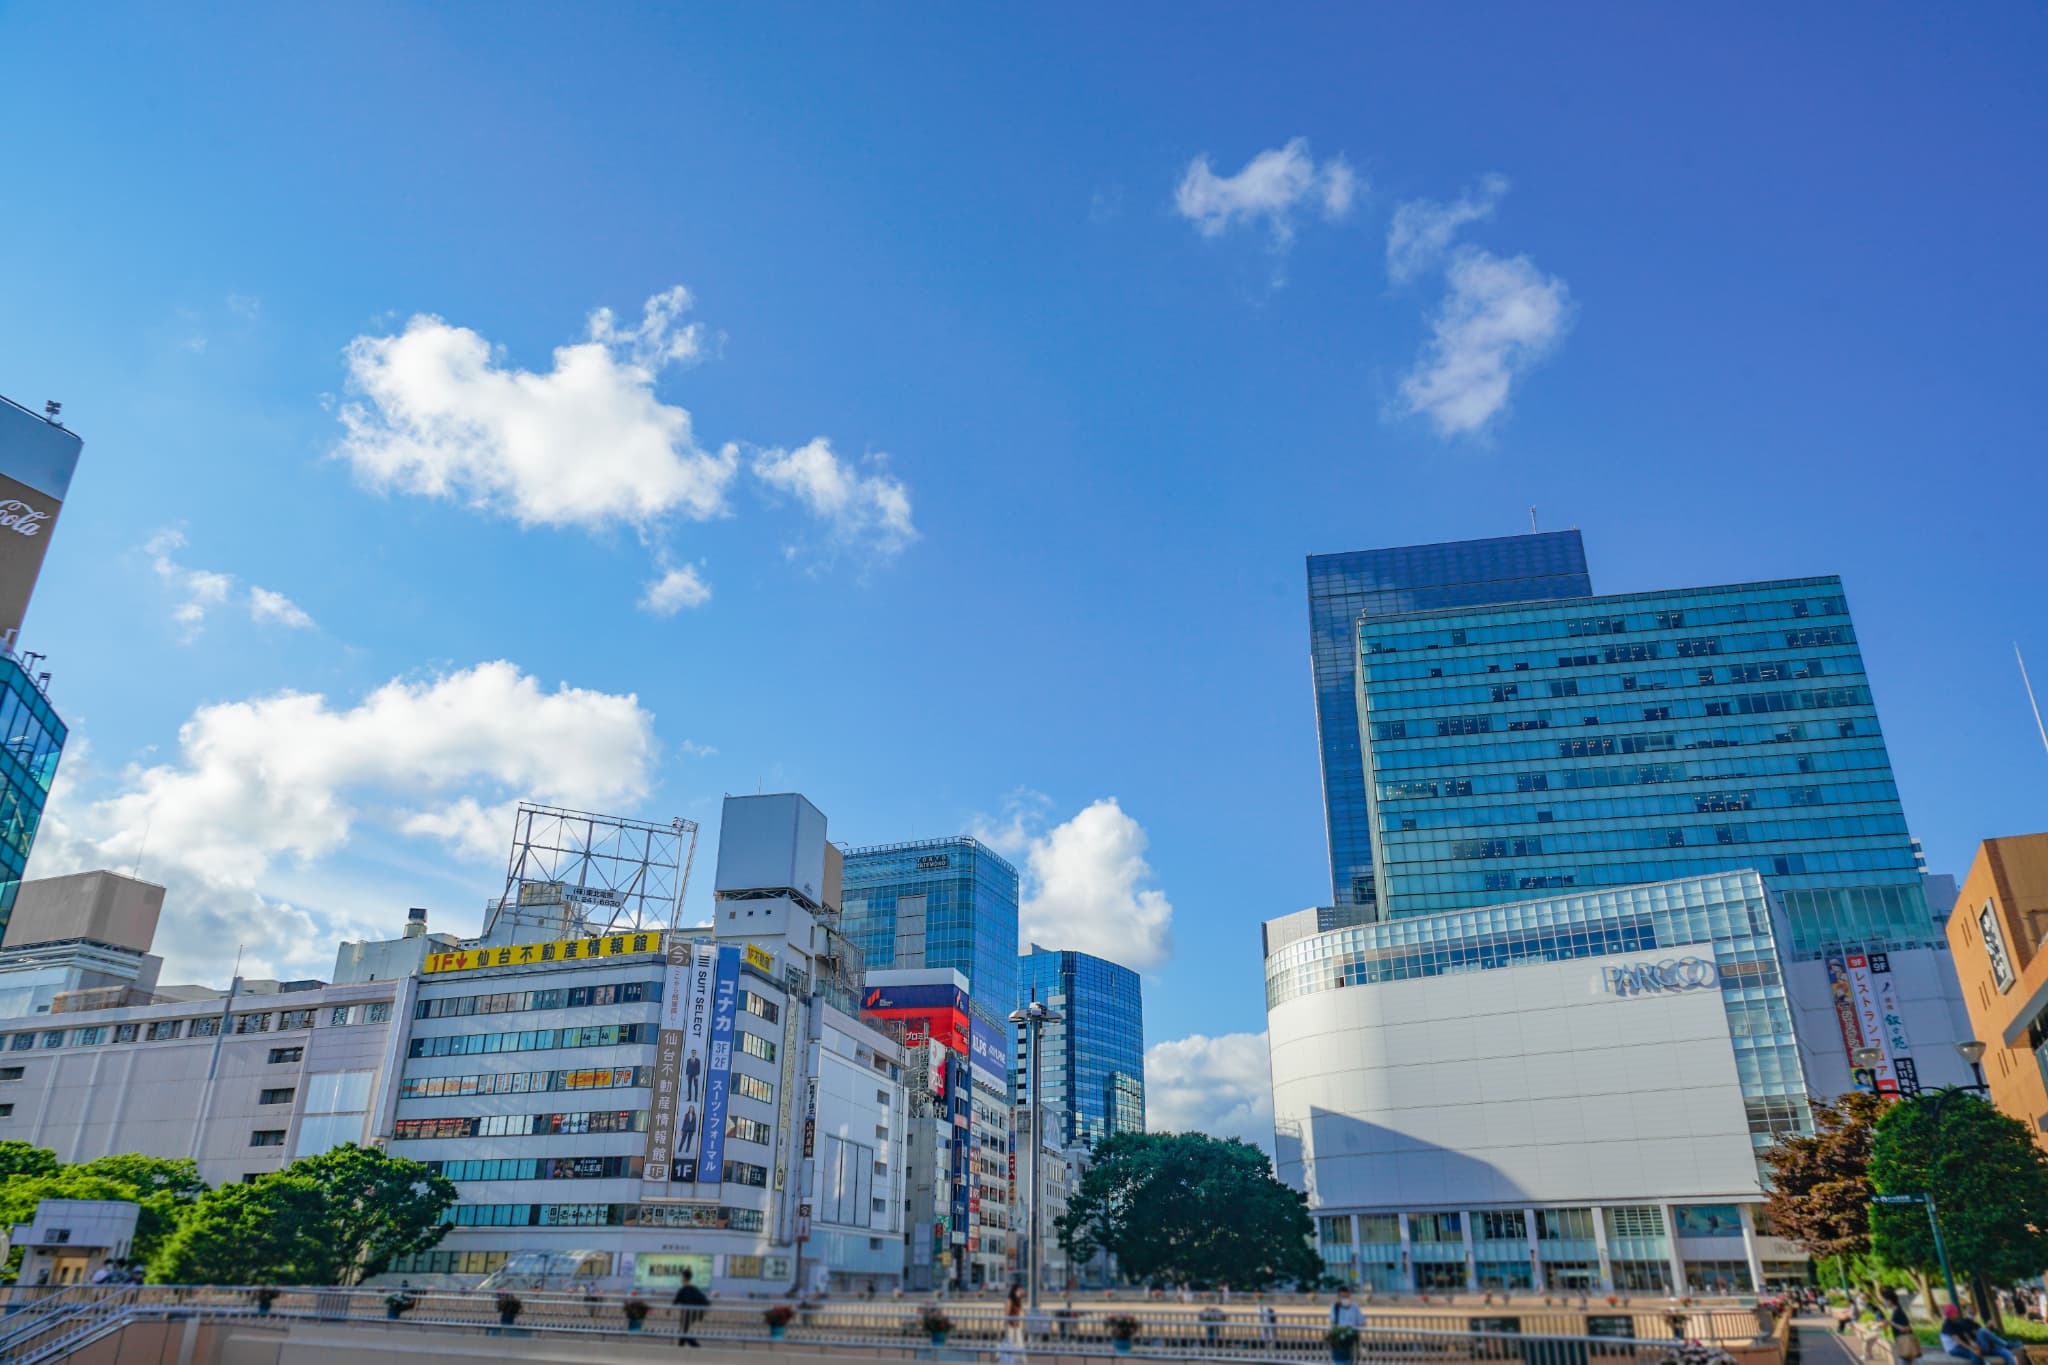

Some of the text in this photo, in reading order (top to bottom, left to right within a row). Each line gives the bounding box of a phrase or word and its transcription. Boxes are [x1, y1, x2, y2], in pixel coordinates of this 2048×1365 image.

[433, 934, 648, 971] 1F 仙台不動産情報館
[1873, 963, 1888, 971] 9F
[1600, 956, 1707, 993] PARCO
[692, 970, 708, 1038] SUIT SELECT
[715, 980, 735, 1032] コナカ
[714, 1056, 726, 1068] 2F
[715, 1043, 728, 1053] 3F
[651, 1032, 678, 1162] 仙台不動産情報館
[705, 1080, 723, 1172] スーツ・フォーマル
[674, 1164, 692, 1178] 1F
